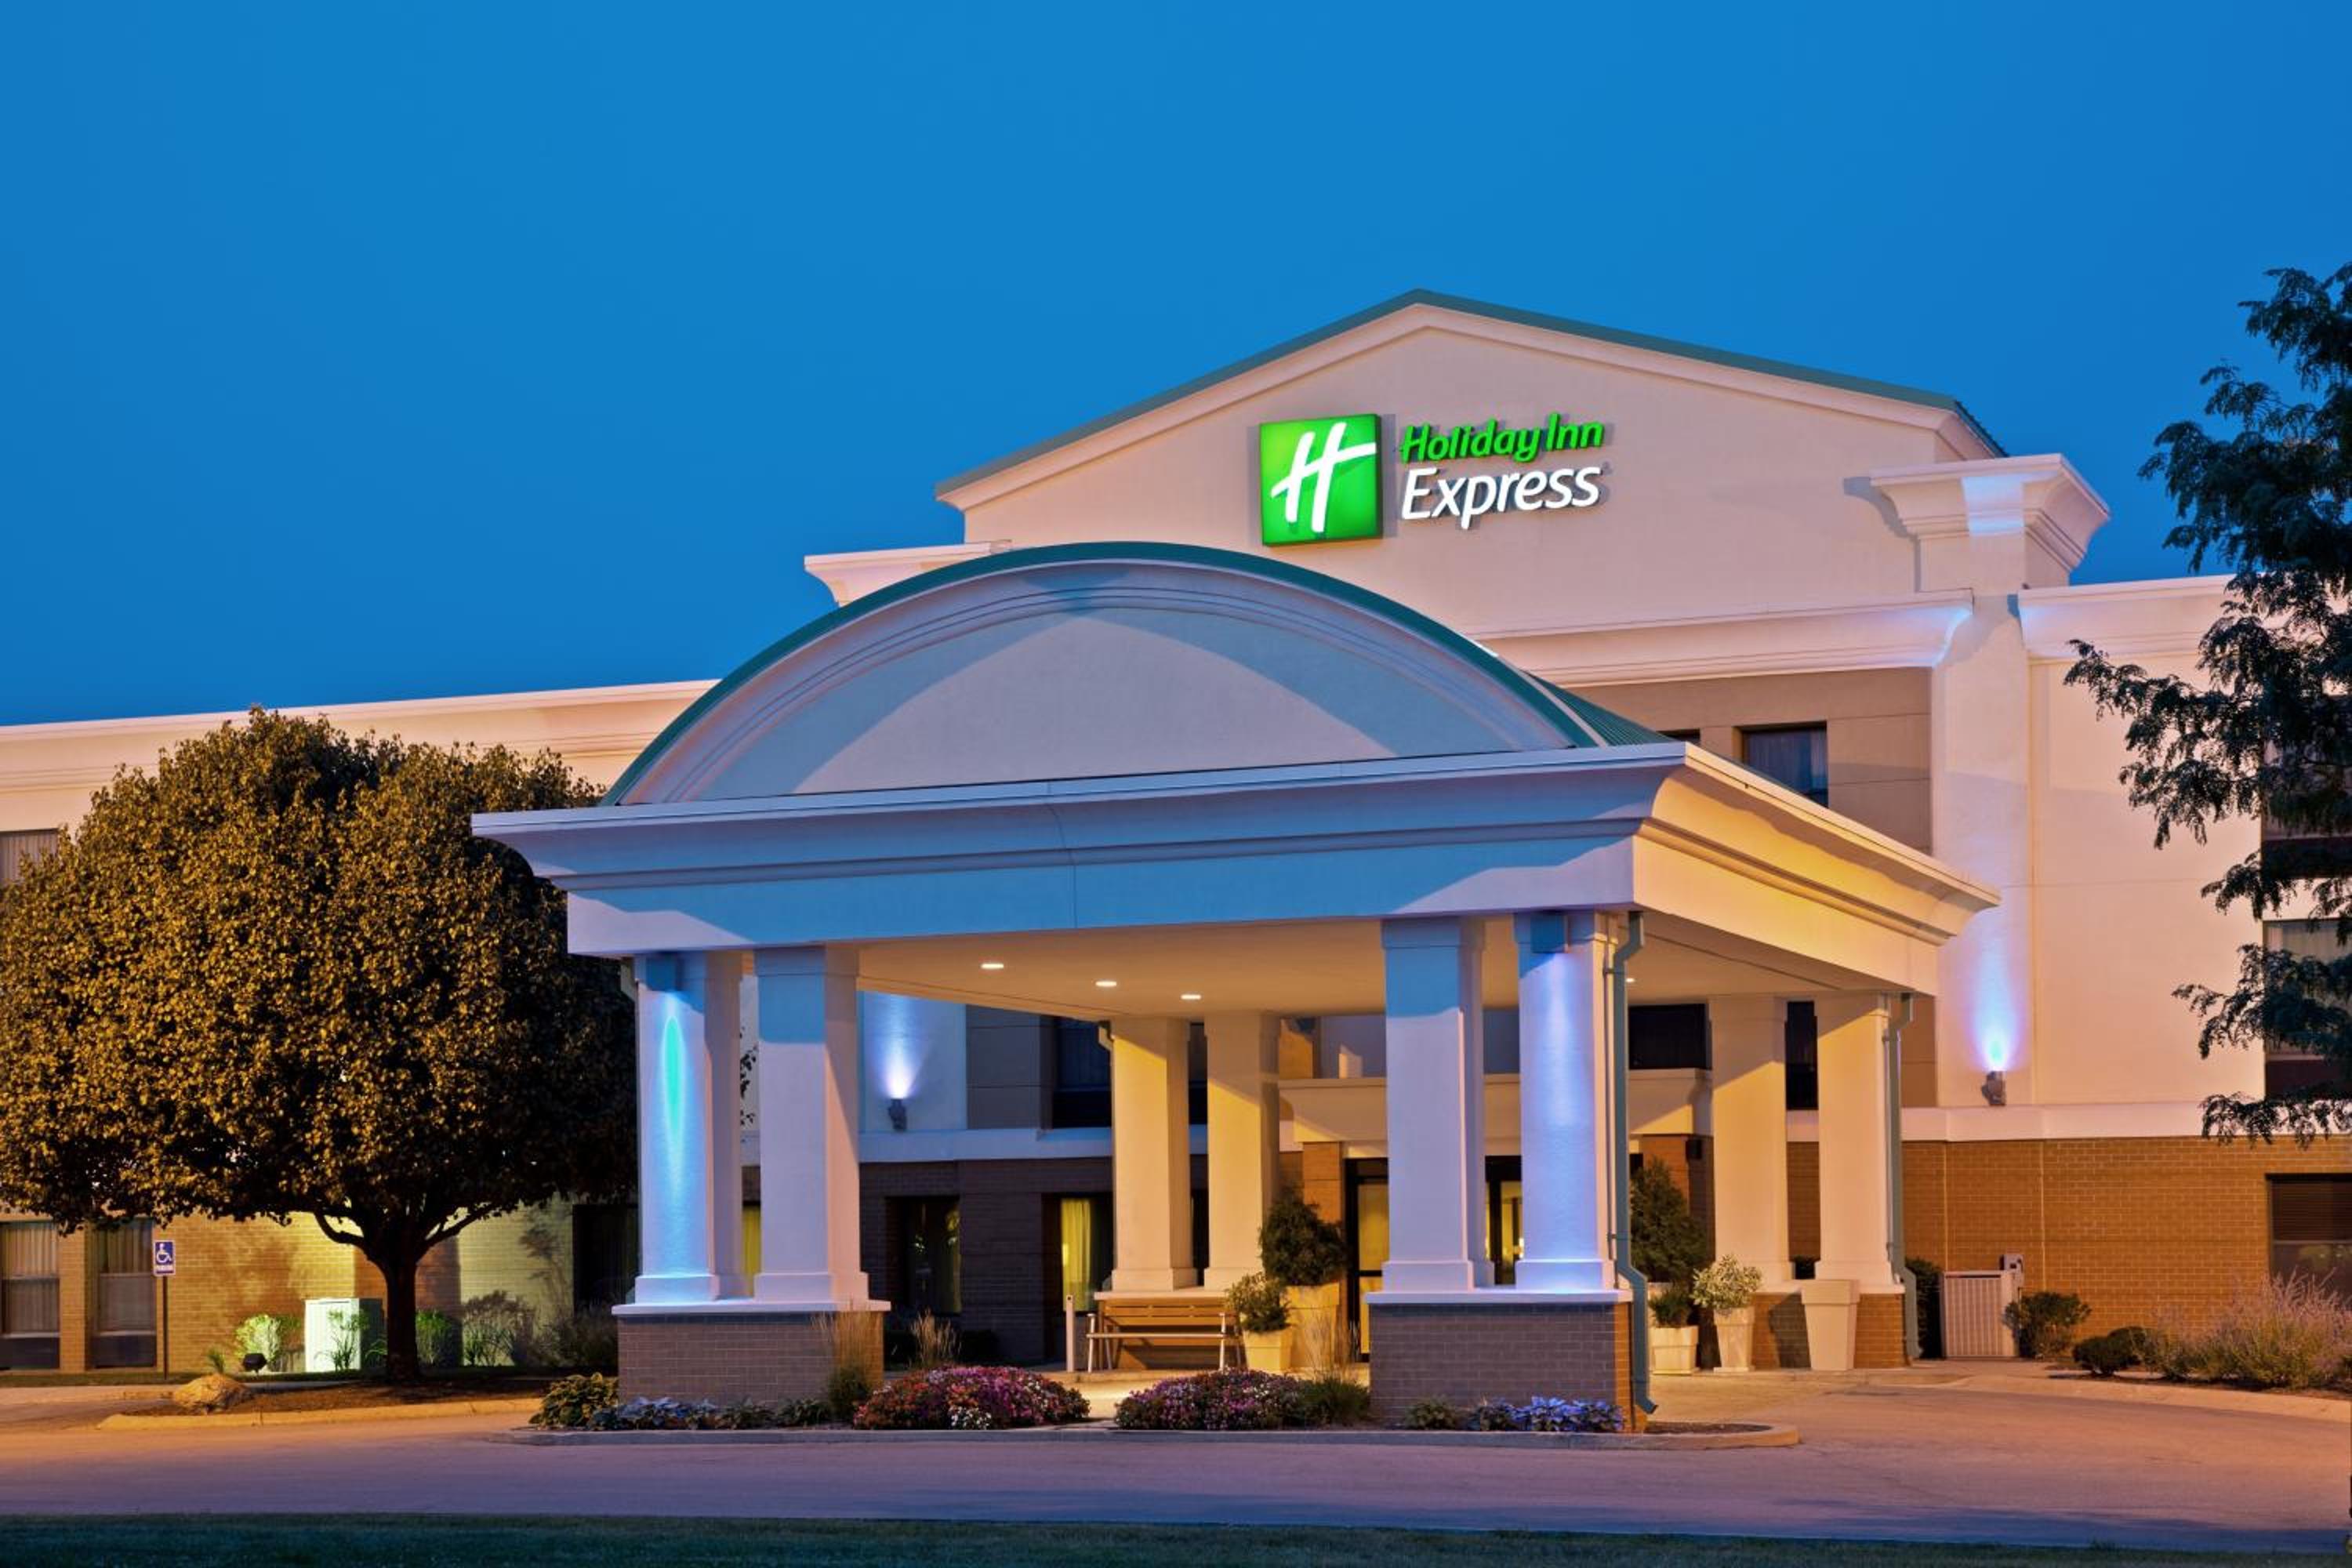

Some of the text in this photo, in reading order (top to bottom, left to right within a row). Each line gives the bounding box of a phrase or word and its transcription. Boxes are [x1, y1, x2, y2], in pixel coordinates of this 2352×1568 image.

[1399, 412, 1605, 463] Holiday Inn
[1401, 466, 1602, 529] Express
